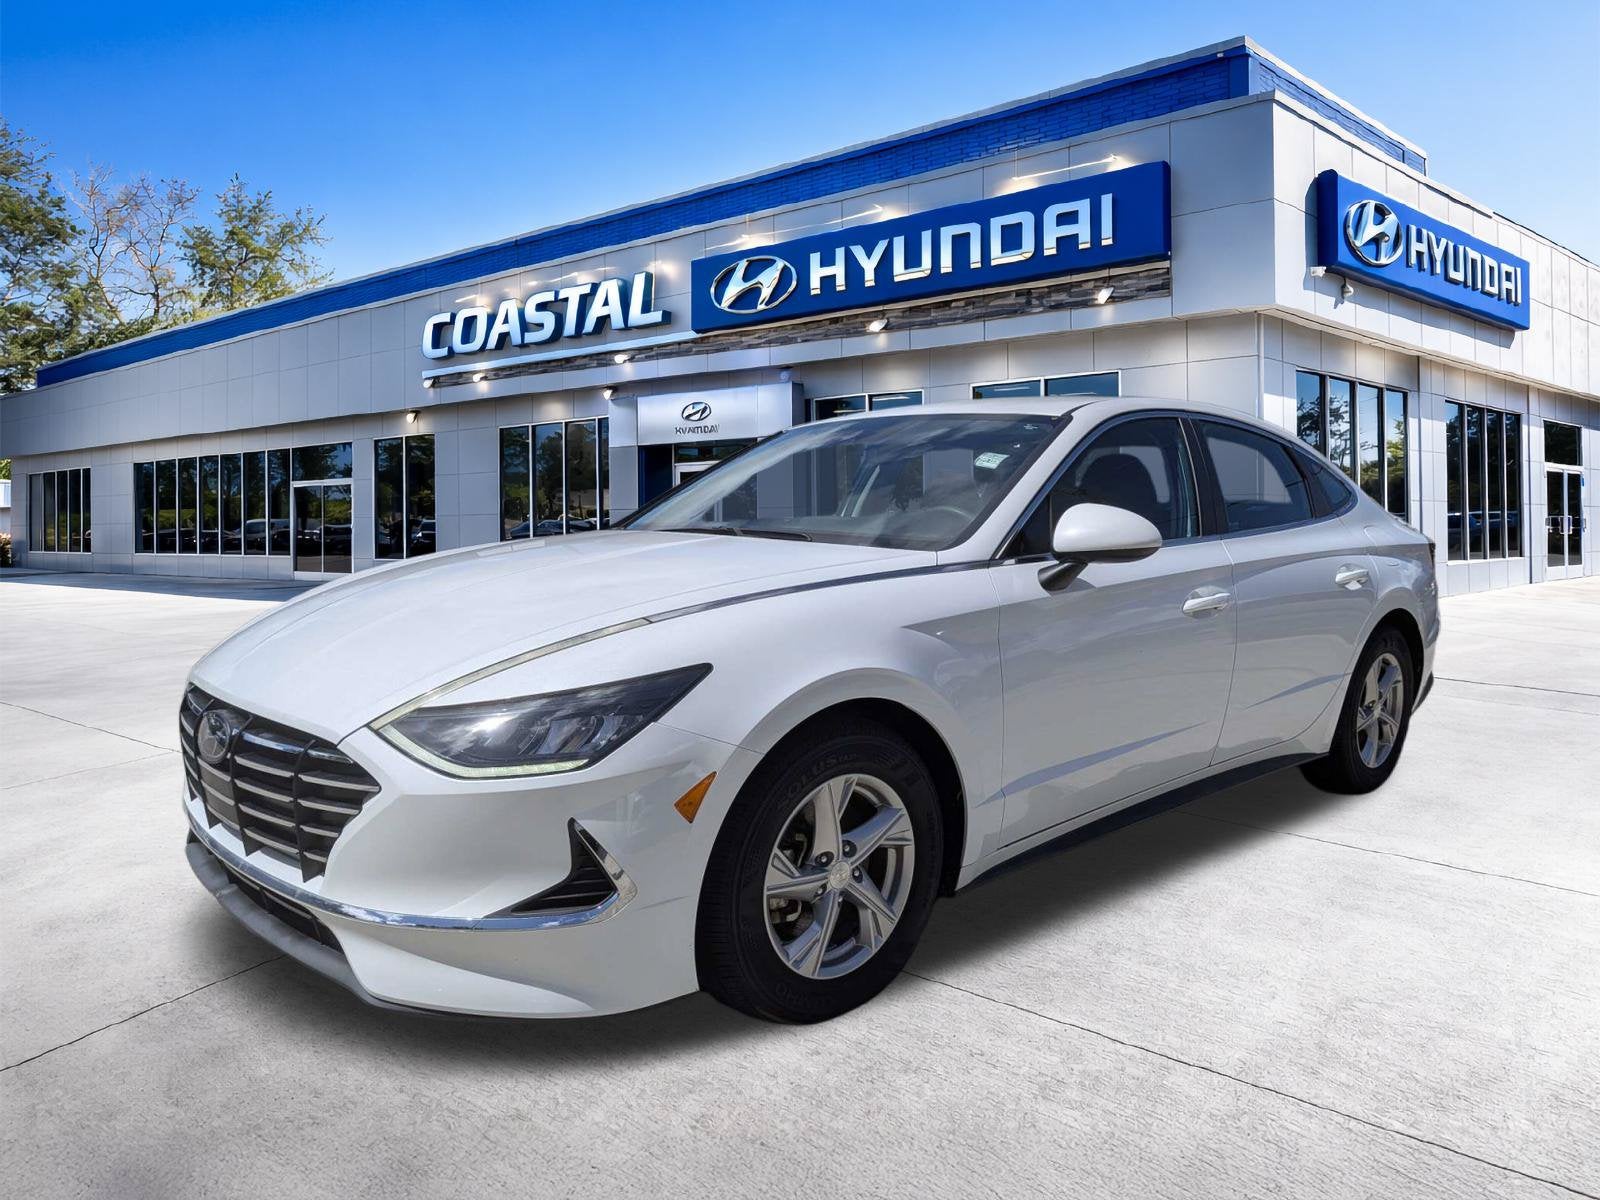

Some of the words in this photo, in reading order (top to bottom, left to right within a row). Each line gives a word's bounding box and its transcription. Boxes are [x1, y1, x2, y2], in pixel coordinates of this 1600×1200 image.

[809, 192, 1114, 295] HYUNDAI
[1406, 224, 1522, 306] HYUNDAI
[422, 271, 668, 359] COASTAL
